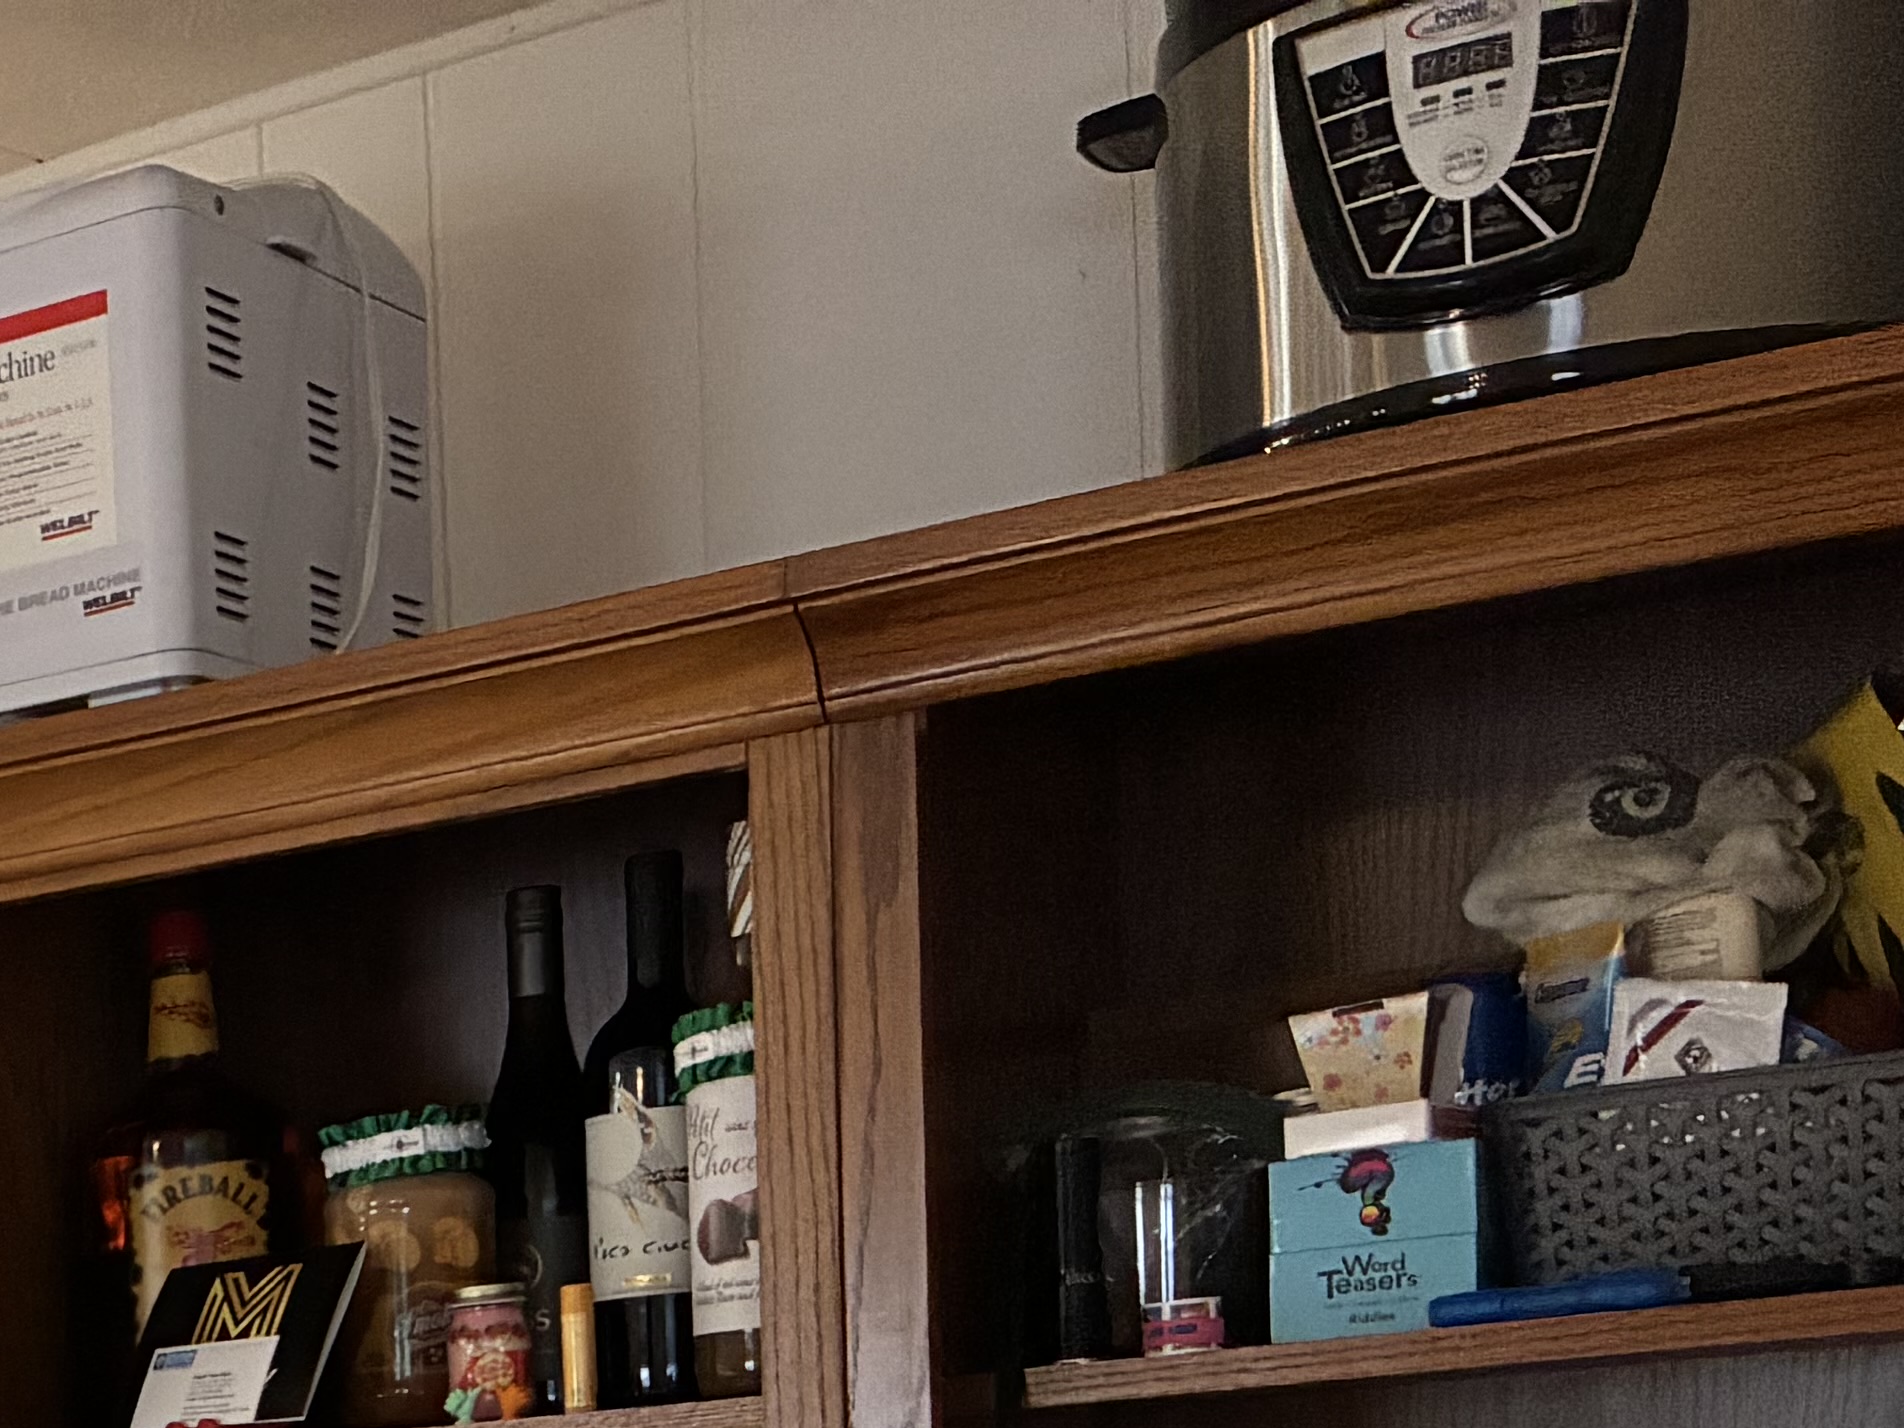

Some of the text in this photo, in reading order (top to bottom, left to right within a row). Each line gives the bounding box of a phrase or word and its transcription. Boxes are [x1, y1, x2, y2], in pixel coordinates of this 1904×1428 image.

[17, 585, 71, 612] BREAD
[73, 566, 141, 597] MACHINE
[1342, 1251, 1406, 1277] Word
[1317, 1270, 1420, 1300] Teasers
